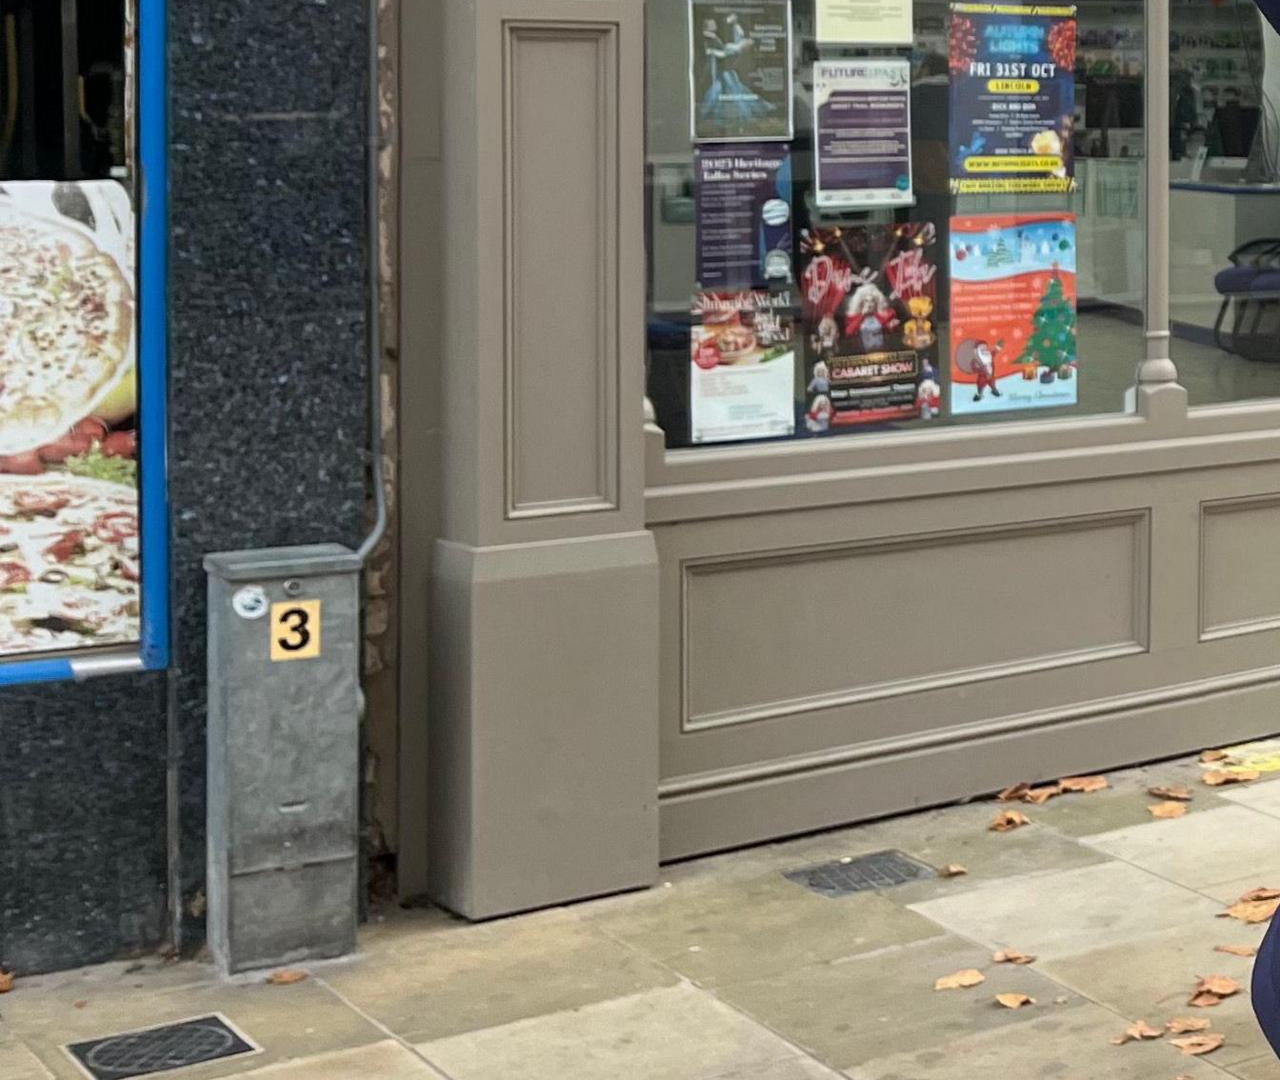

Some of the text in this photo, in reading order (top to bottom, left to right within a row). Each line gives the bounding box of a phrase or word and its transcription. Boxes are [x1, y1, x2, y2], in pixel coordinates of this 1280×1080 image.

[969, 61, 1057, 78] FRI 31ST OCT
[832, 361, 914, 378] CABARET SHOW
[278, 607, 311, 651] 3
